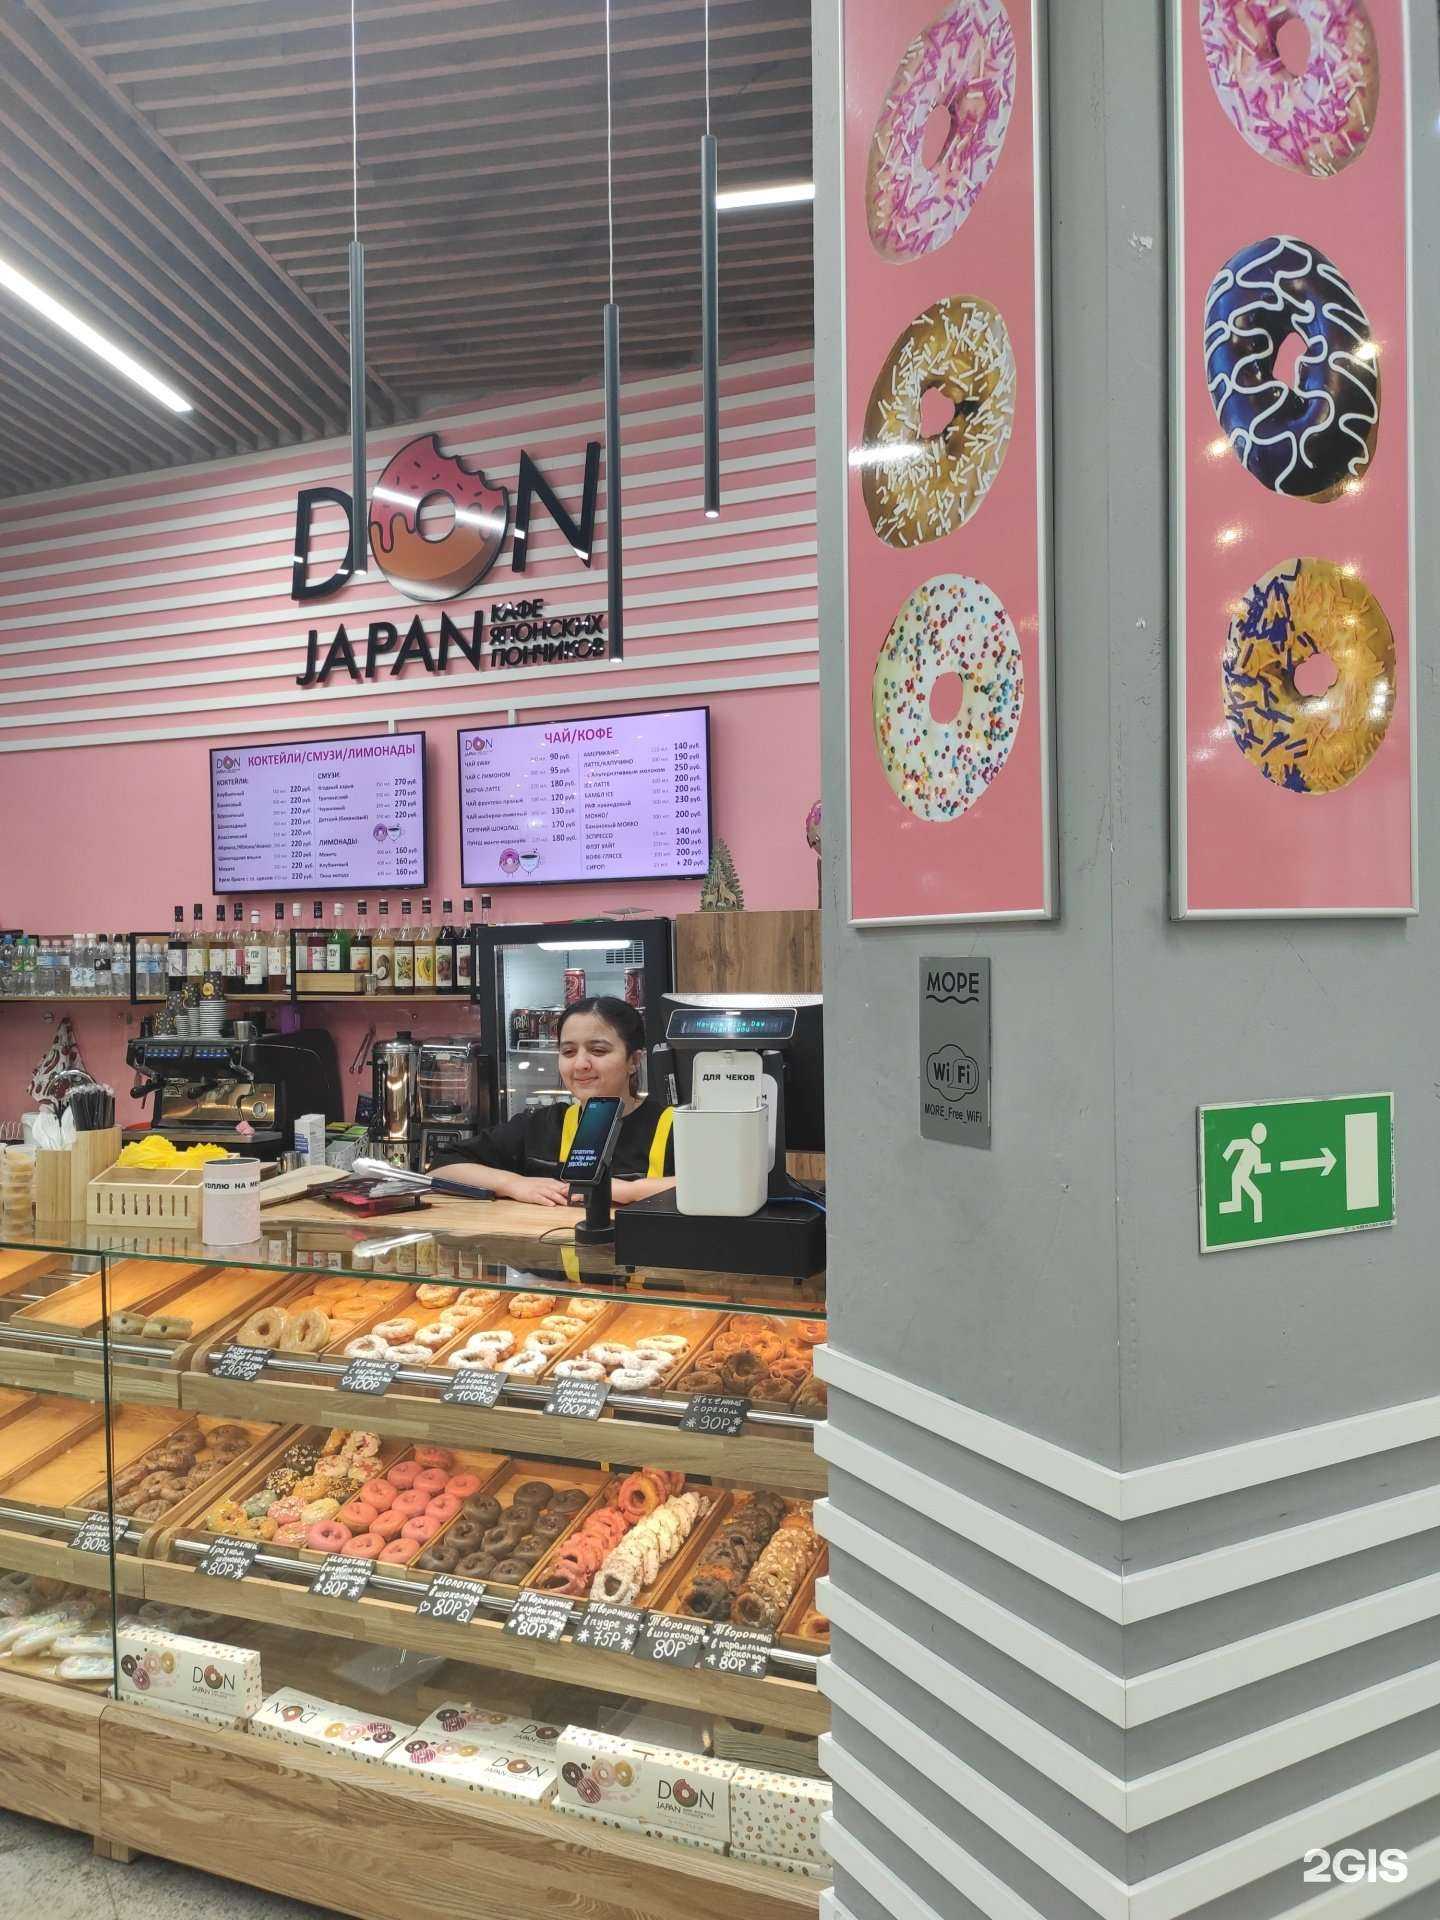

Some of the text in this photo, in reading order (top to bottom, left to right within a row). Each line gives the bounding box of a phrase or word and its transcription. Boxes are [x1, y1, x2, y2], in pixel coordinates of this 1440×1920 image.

[491, 599, 544, 623] КАФЕ
[490, 614, 604, 645] ЯПОНСКИХ
[296, 610, 484, 686] JAPAN
[491, 638, 605, 667] ПОНЧИКОВ
[545, 727, 613, 743] ЧАЙ/КОФЕ
[674, 742, 688, 750] 140
[248, 743, 415, 767] КОКТЕЙЛИ/СМУЗИ/ЛИМОНАДЫ
[674, 763, 688, 771] 250
[675, 795, 689, 803] 230
[675, 810, 689, 818] 200
[676, 848, 690, 856] 200
[703, 1073, 755, 1081] ДЛЯ ЧЕКОВ
[924, 1103, 982, 1123] MORE_Free_WiFi
[350, 1381, 380, 1391] 100Р
[457, 1390, 486, 1402] 100Р
[558, 1401, 587, 1415] 100Р
[699, 1415, 731, 1430] 90Р
[82, 1537, 106, 1550] 80Р
[207, 1561, 234, 1575] 80Р
[322, 1580, 348, 1597] 80Р
[433, 1599, 462, 1616] 80Р
[517, 1621, 547, 1638] 80Р
[590, 1619, 620, 1631] пудре
[593, 1630, 621, 1647] 75Р
[653, 1631, 699, 1645] шоколаде
[653, 1639, 686, 1659] 80Р
[719, 1656, 746, 1672] 80Р
[521, 1724, 560, 1739] DO
[658, 1778, 715, 1812] DON
[656, 1801, 681, 1813] JAPAN
